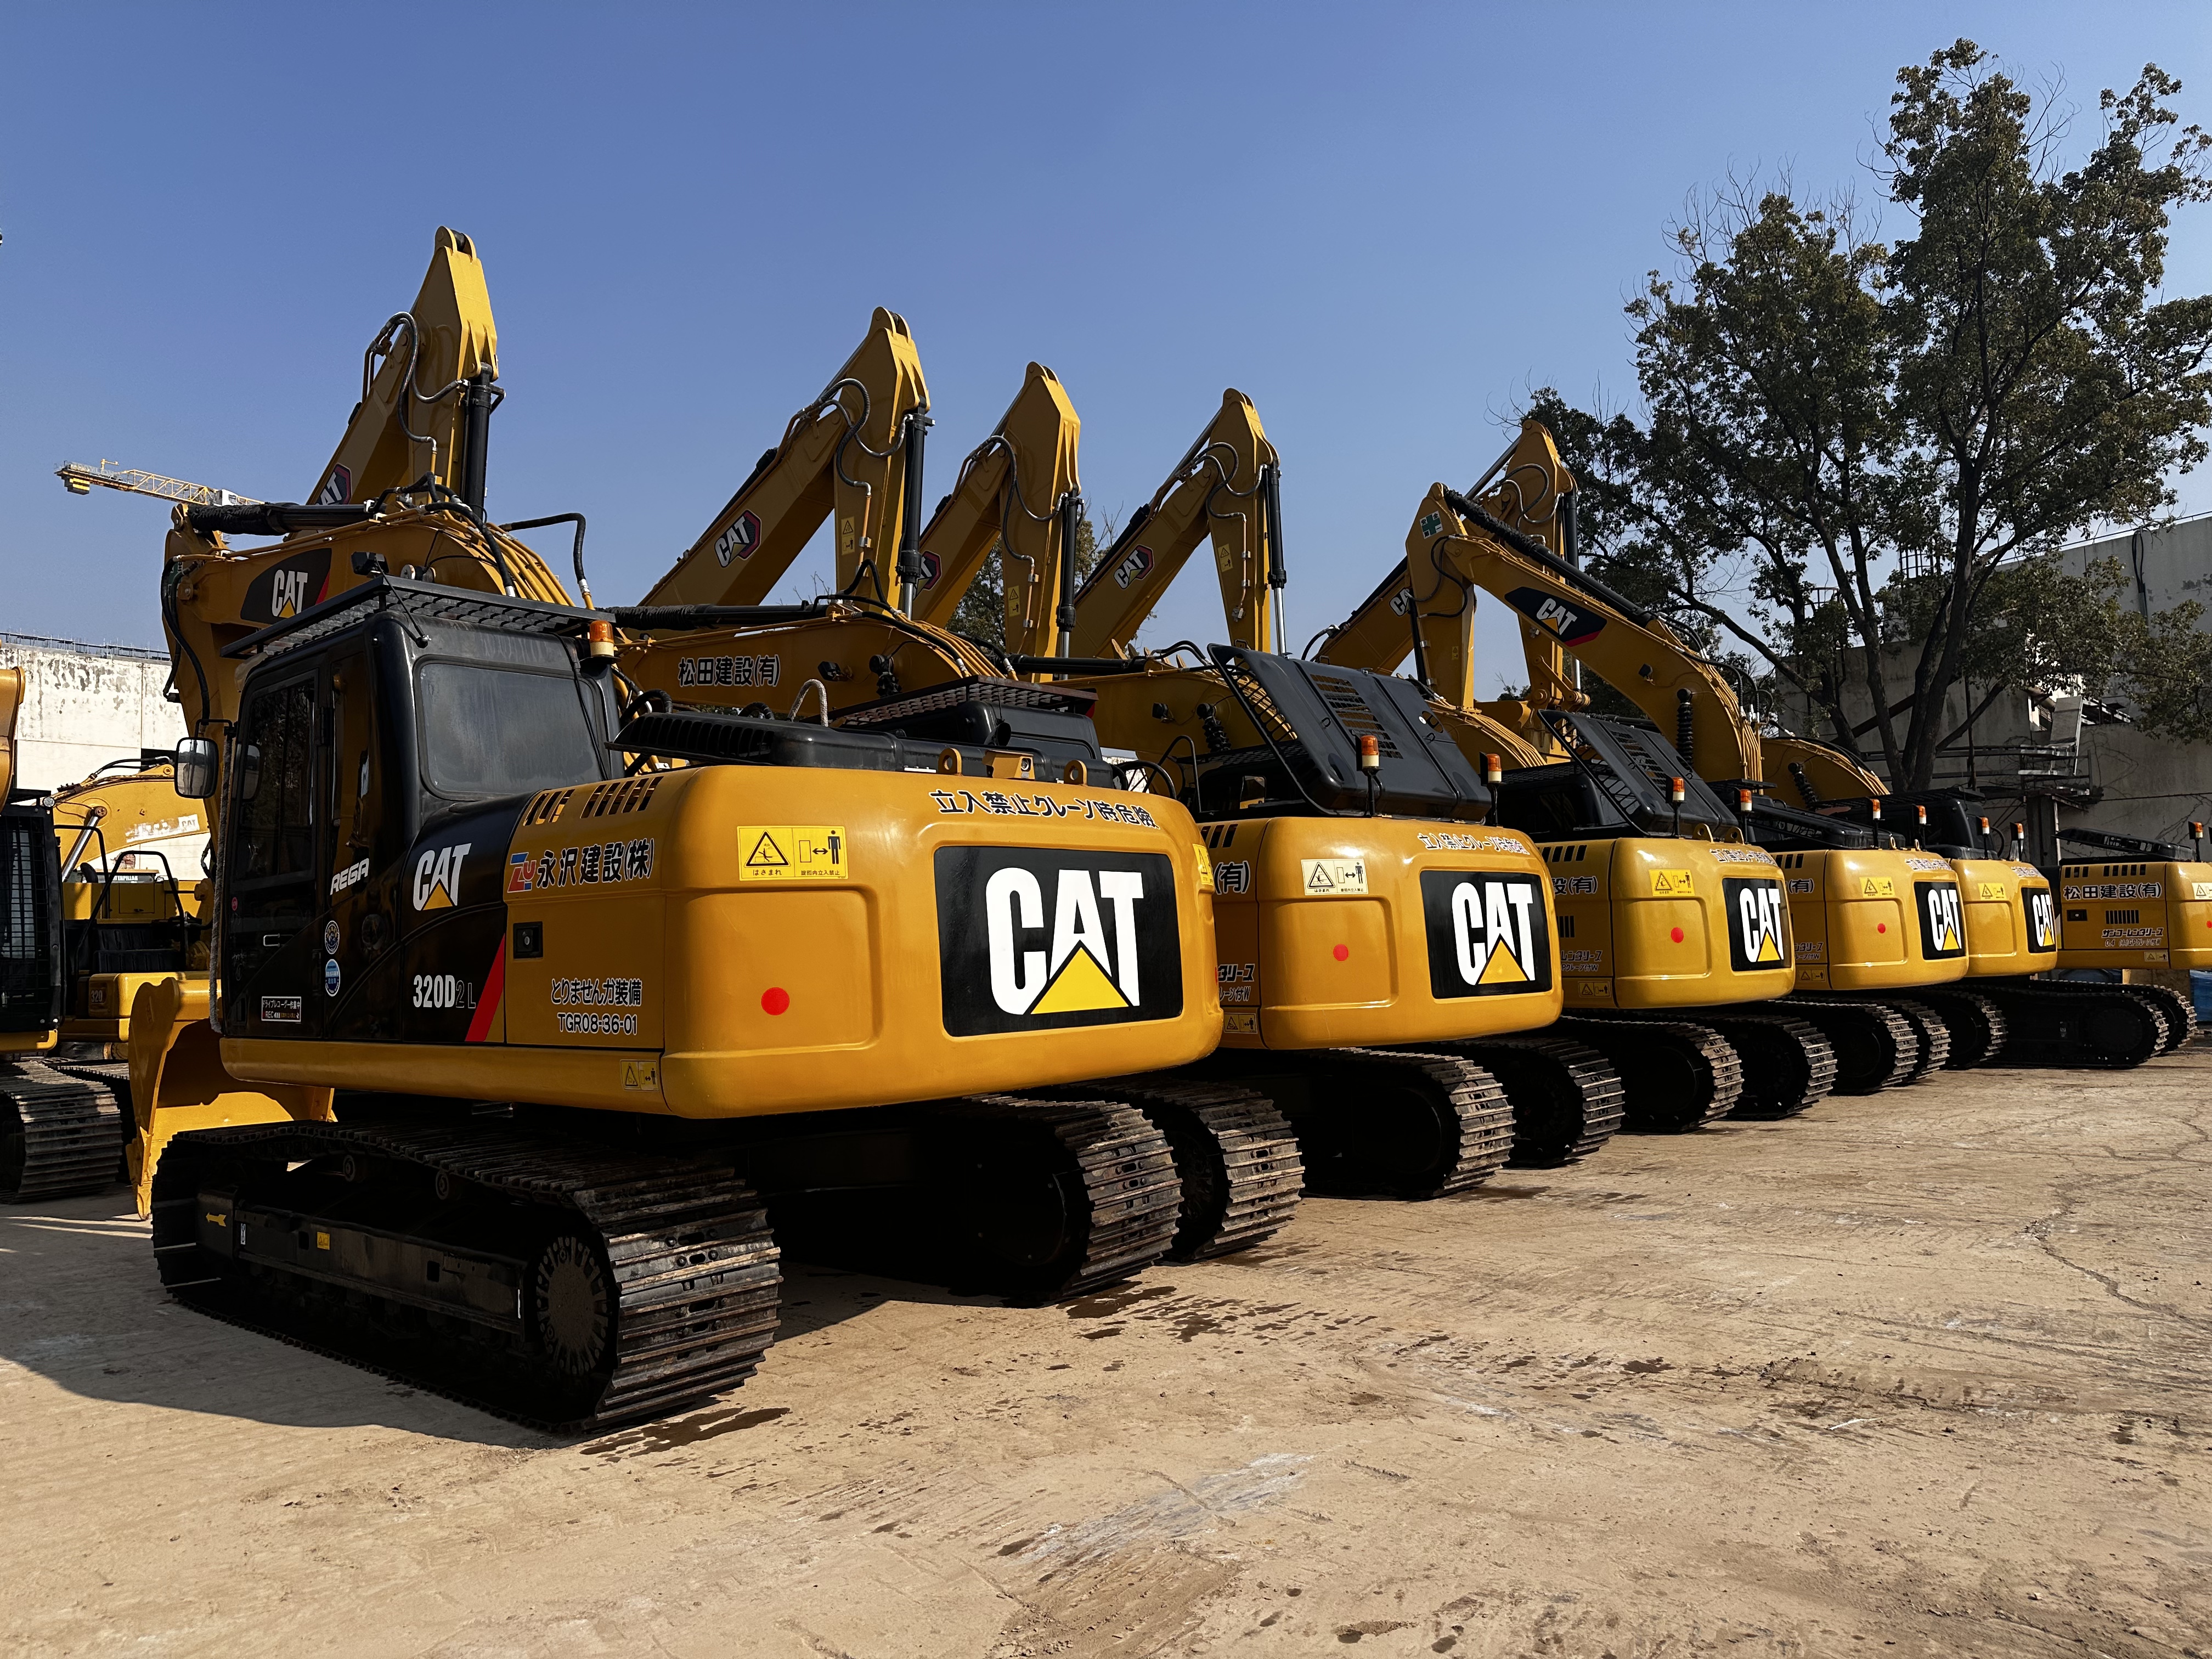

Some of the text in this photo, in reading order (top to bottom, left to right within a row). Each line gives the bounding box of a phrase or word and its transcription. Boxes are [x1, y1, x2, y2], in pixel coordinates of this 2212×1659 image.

[315, 472, 342, 505] AT
[715, 516, 749, 567] CAT
[1114, 550, 1144, 588] CAT
[272, 569, 308, 617] CAT
[1390, 589, 1409, 616] CA
[1536, 598, 1578, 635] CAT
[678, 654, 780, 687] 松田建設(有)
[330, 858, 370, 895] REGA
[413, 843, 471, 911] CAT
[537, 838, 654, 889] 永沢建設(株)
[2063, 882, 2162, 900] 松田建設(有)
[986, 867, 1144, 1015] CAT
[1452, 882, 1536, 985] CAT
[1740, 888, 1784, 962] CAT
[1928, 889, 1962, 951] CAT
[2033, 895, 2055, 946] CAT
[91, 990, 103, 1002] 320
[557, 1012, 638, 1036] TGR08-36-01
